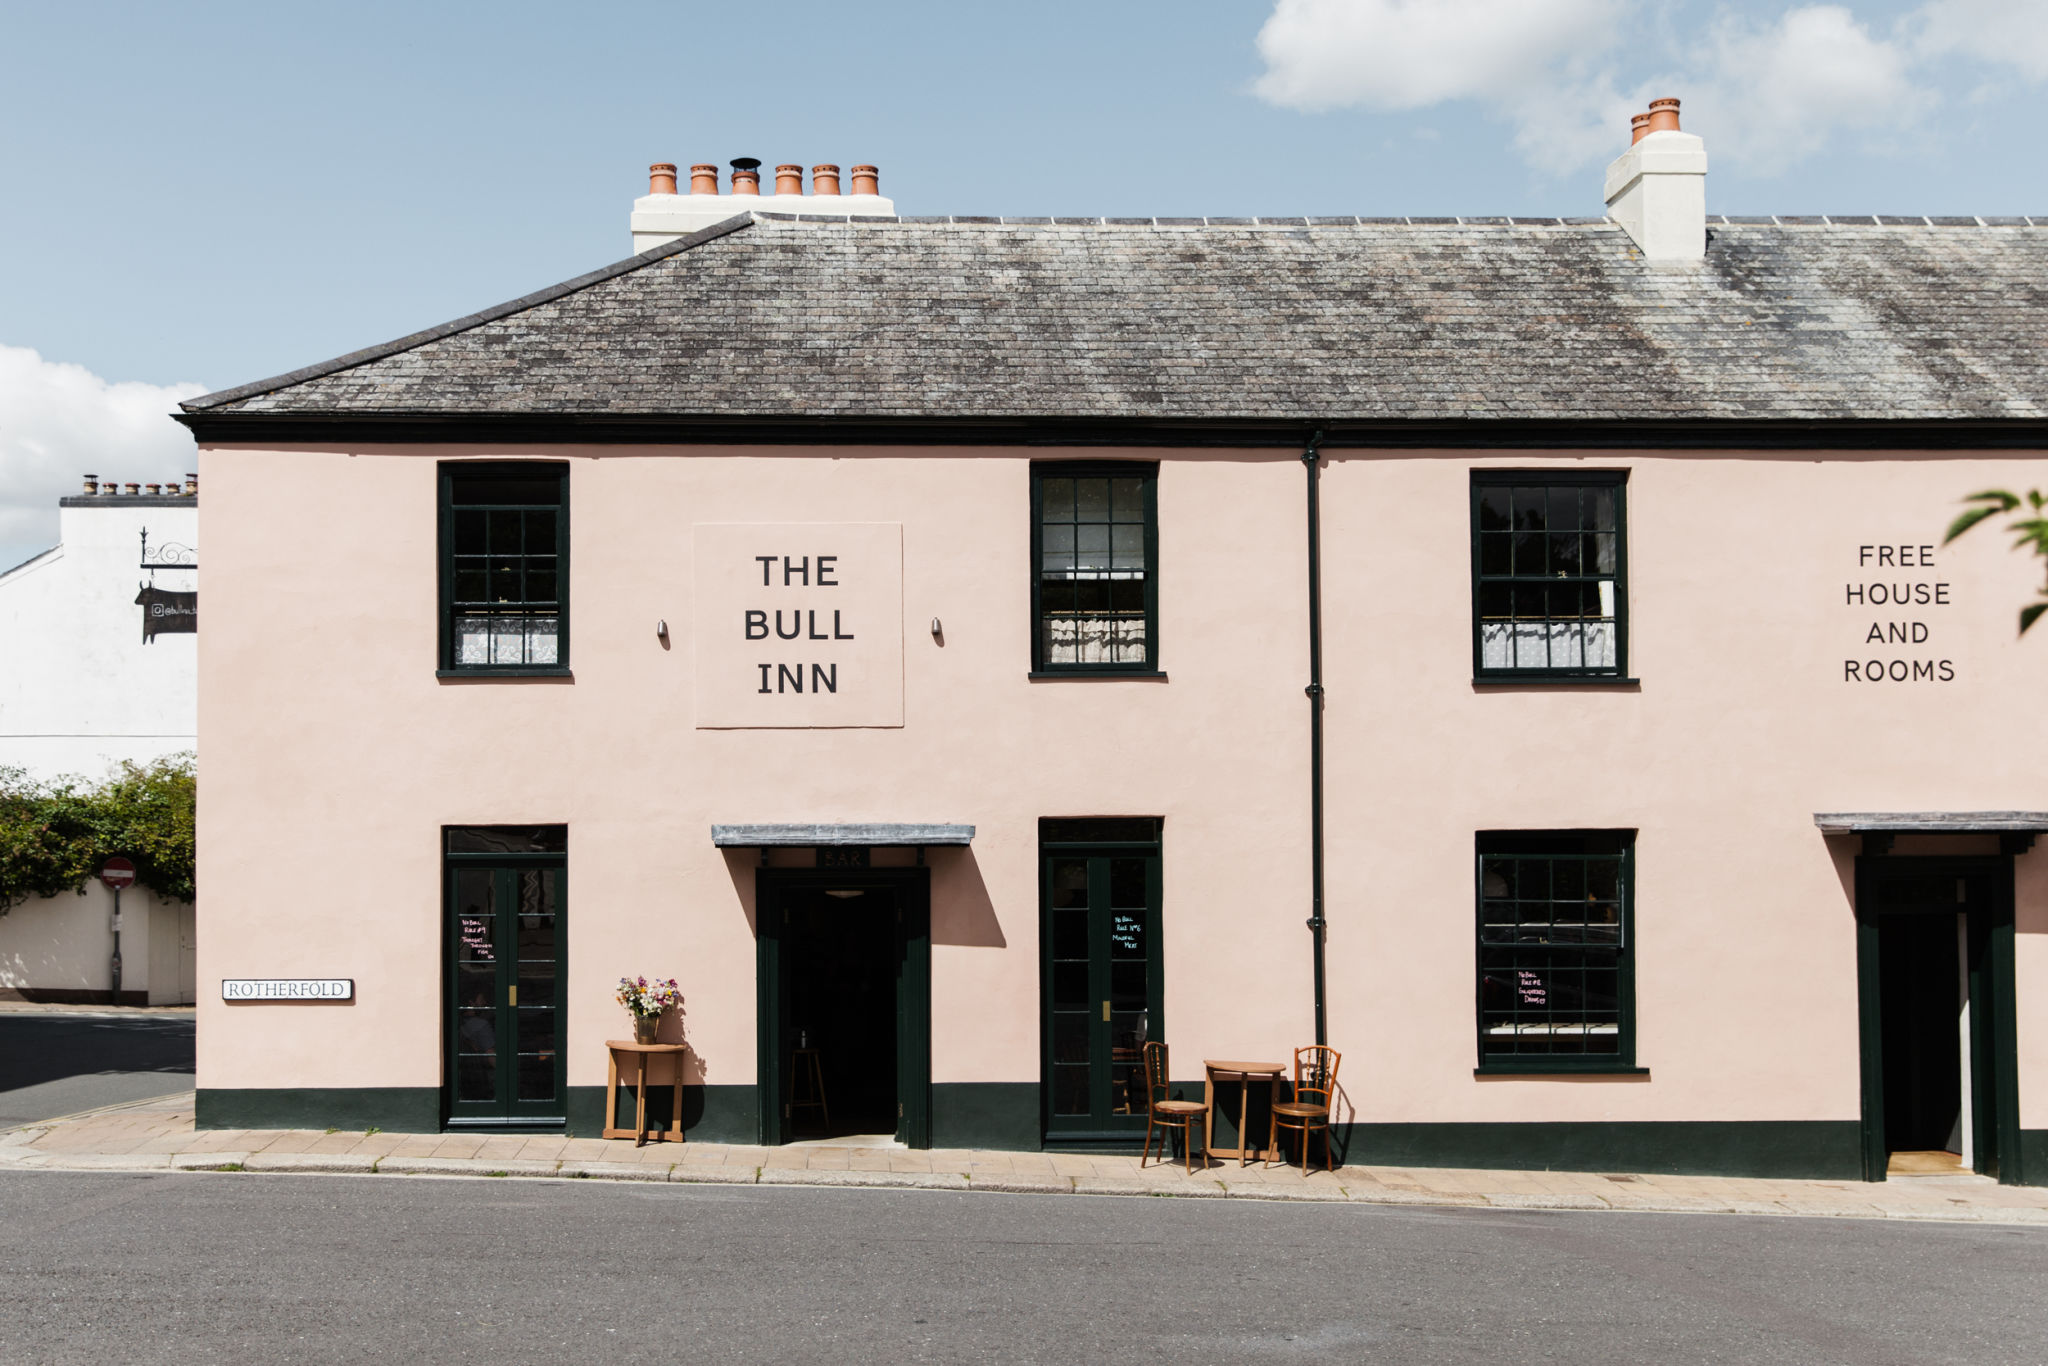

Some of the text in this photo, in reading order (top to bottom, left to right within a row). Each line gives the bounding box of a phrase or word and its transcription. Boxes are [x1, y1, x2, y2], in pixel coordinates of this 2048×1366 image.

[1859, 545, 1935, 567] FREE
[755, 556, 839, 586] THE
[1846, 583, 1950, 605] HOUSE
[745, 609, 855, 640] BULL
[1866, 621, 1929, 644] AND
[757, 663, 837, 694] INN
[1844, 659, 1955, 682] ROOMS
[824, 850, 862, 867] BAR
[228, 982, 345, 997] ROTHERFOLD
